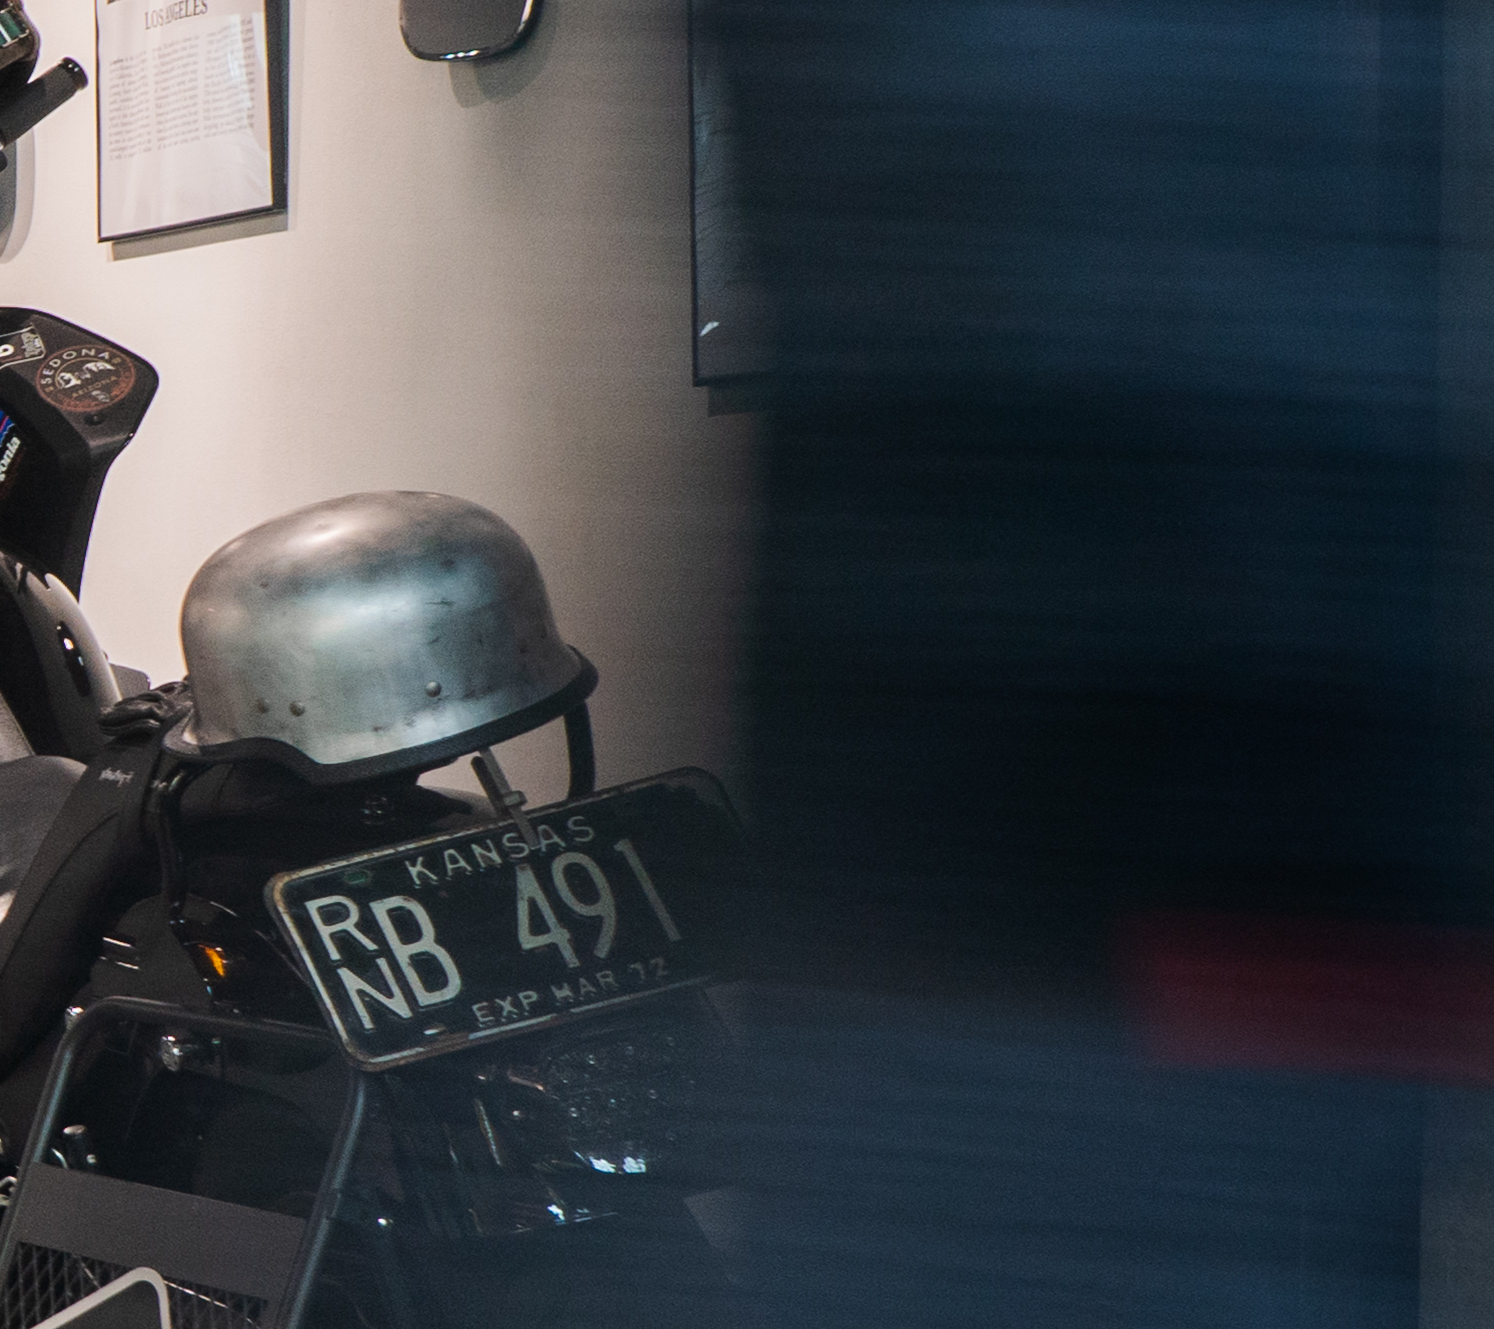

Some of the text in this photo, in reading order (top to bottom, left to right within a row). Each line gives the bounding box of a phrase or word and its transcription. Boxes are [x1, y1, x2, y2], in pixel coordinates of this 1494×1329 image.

[143, 9, 165, 31] LOS
[40, 347, 111, 385] SEDONA
[404, 815, 596, 888] KANSAS
[303, 837, 684, 1008] R B 491
[335, 956, 414, 1031] N
[470, 990, 539, 1029] EXP
[550, 969, 620, 1002] MAR
